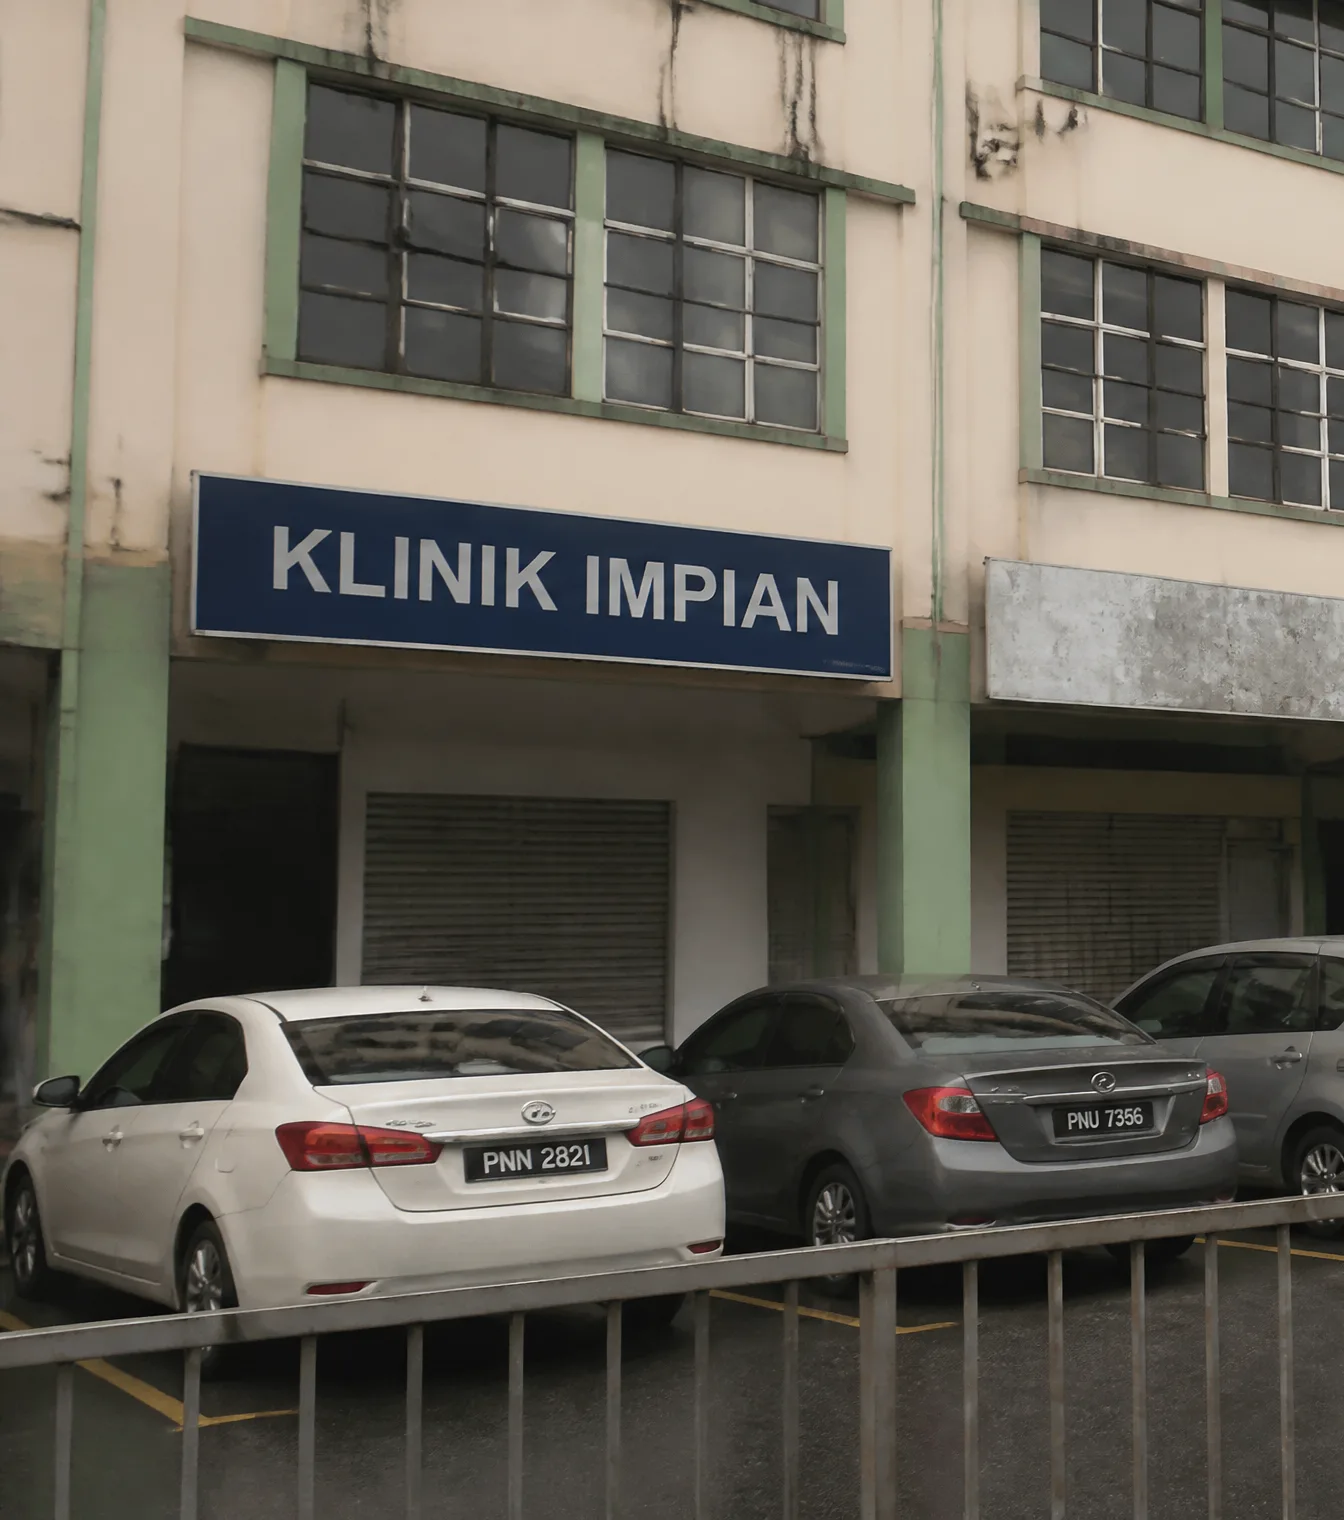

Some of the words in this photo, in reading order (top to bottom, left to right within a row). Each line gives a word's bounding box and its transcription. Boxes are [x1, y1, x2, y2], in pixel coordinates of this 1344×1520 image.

[272, 525, 558, 612] KLINIK
[585, 554, 840, 636] IMPIAN
[1067, 1110, 1100, 1130] PNU
[1104, 1107, 1144, 1128] 7356
[483, 1148, 533, 1174] PNN
[540, 1144, 591, 1169] 2821
